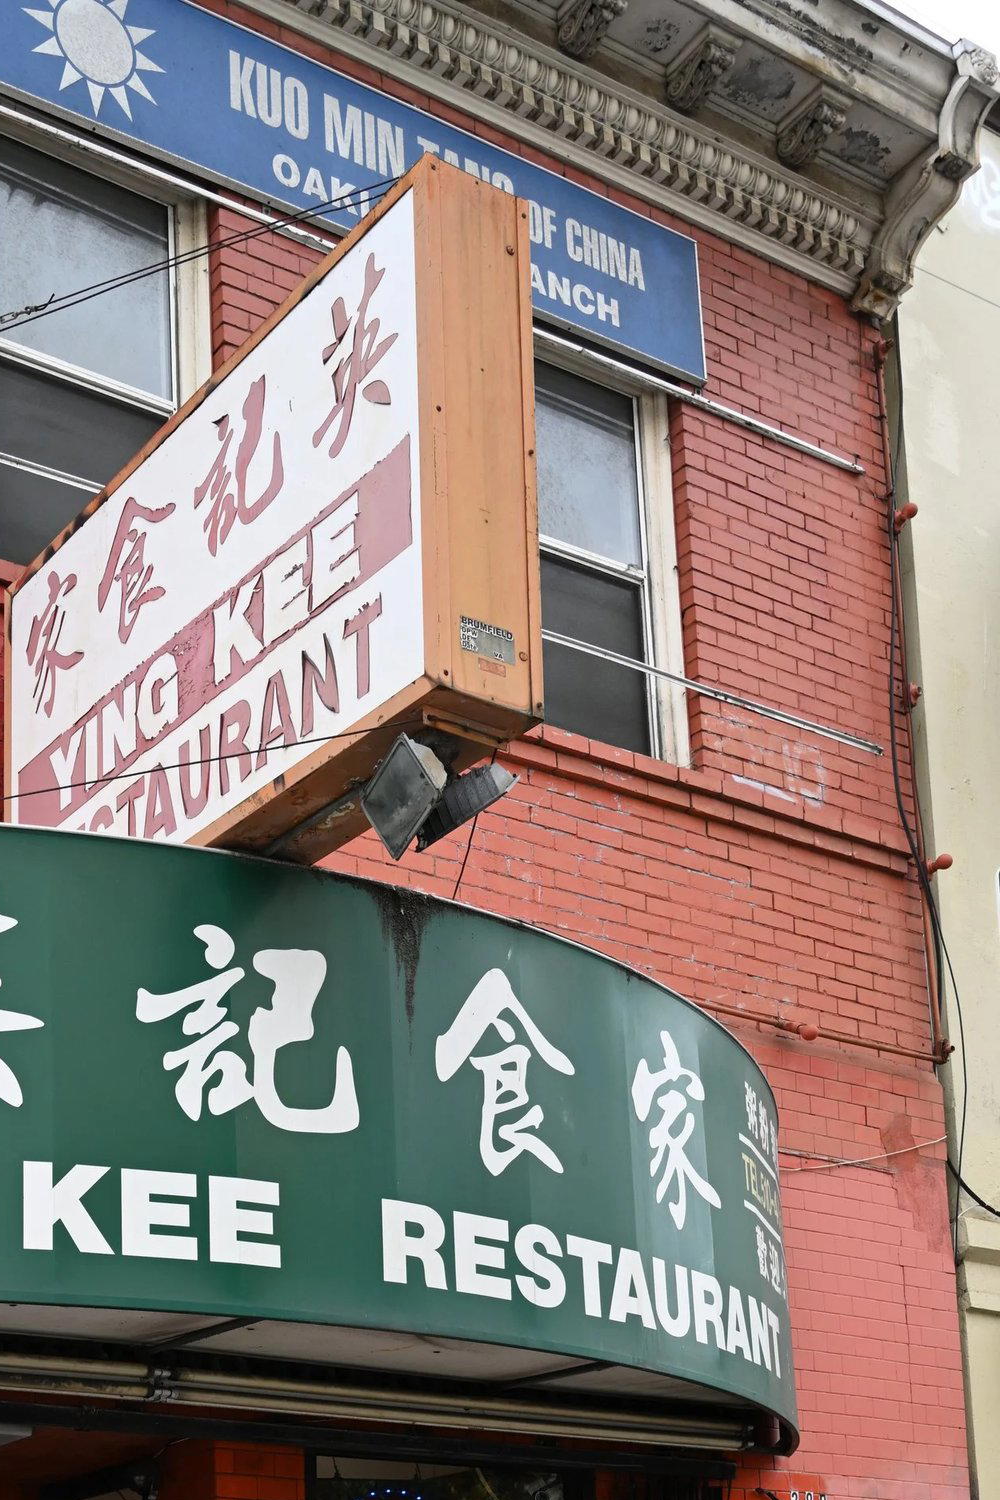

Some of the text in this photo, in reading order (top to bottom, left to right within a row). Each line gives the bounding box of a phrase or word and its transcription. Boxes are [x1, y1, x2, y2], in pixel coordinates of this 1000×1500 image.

[229, 50, 309, 140] KUO
[324, 93, 405, 179] MIN
[529, 200, 557, 249] OF
[566, 217, 645, 292] CHINA
[531, 267, 620, 328] ANCH
[49, 488, 362, 811] YING KEE
[77, 592, 382, 839] STAURANT
[461, 615, 513, 640] BRUMFIELD
[23, 1160, 282, 1269] KEE
[381, 1198, 783, 1380] RESTAURANT
